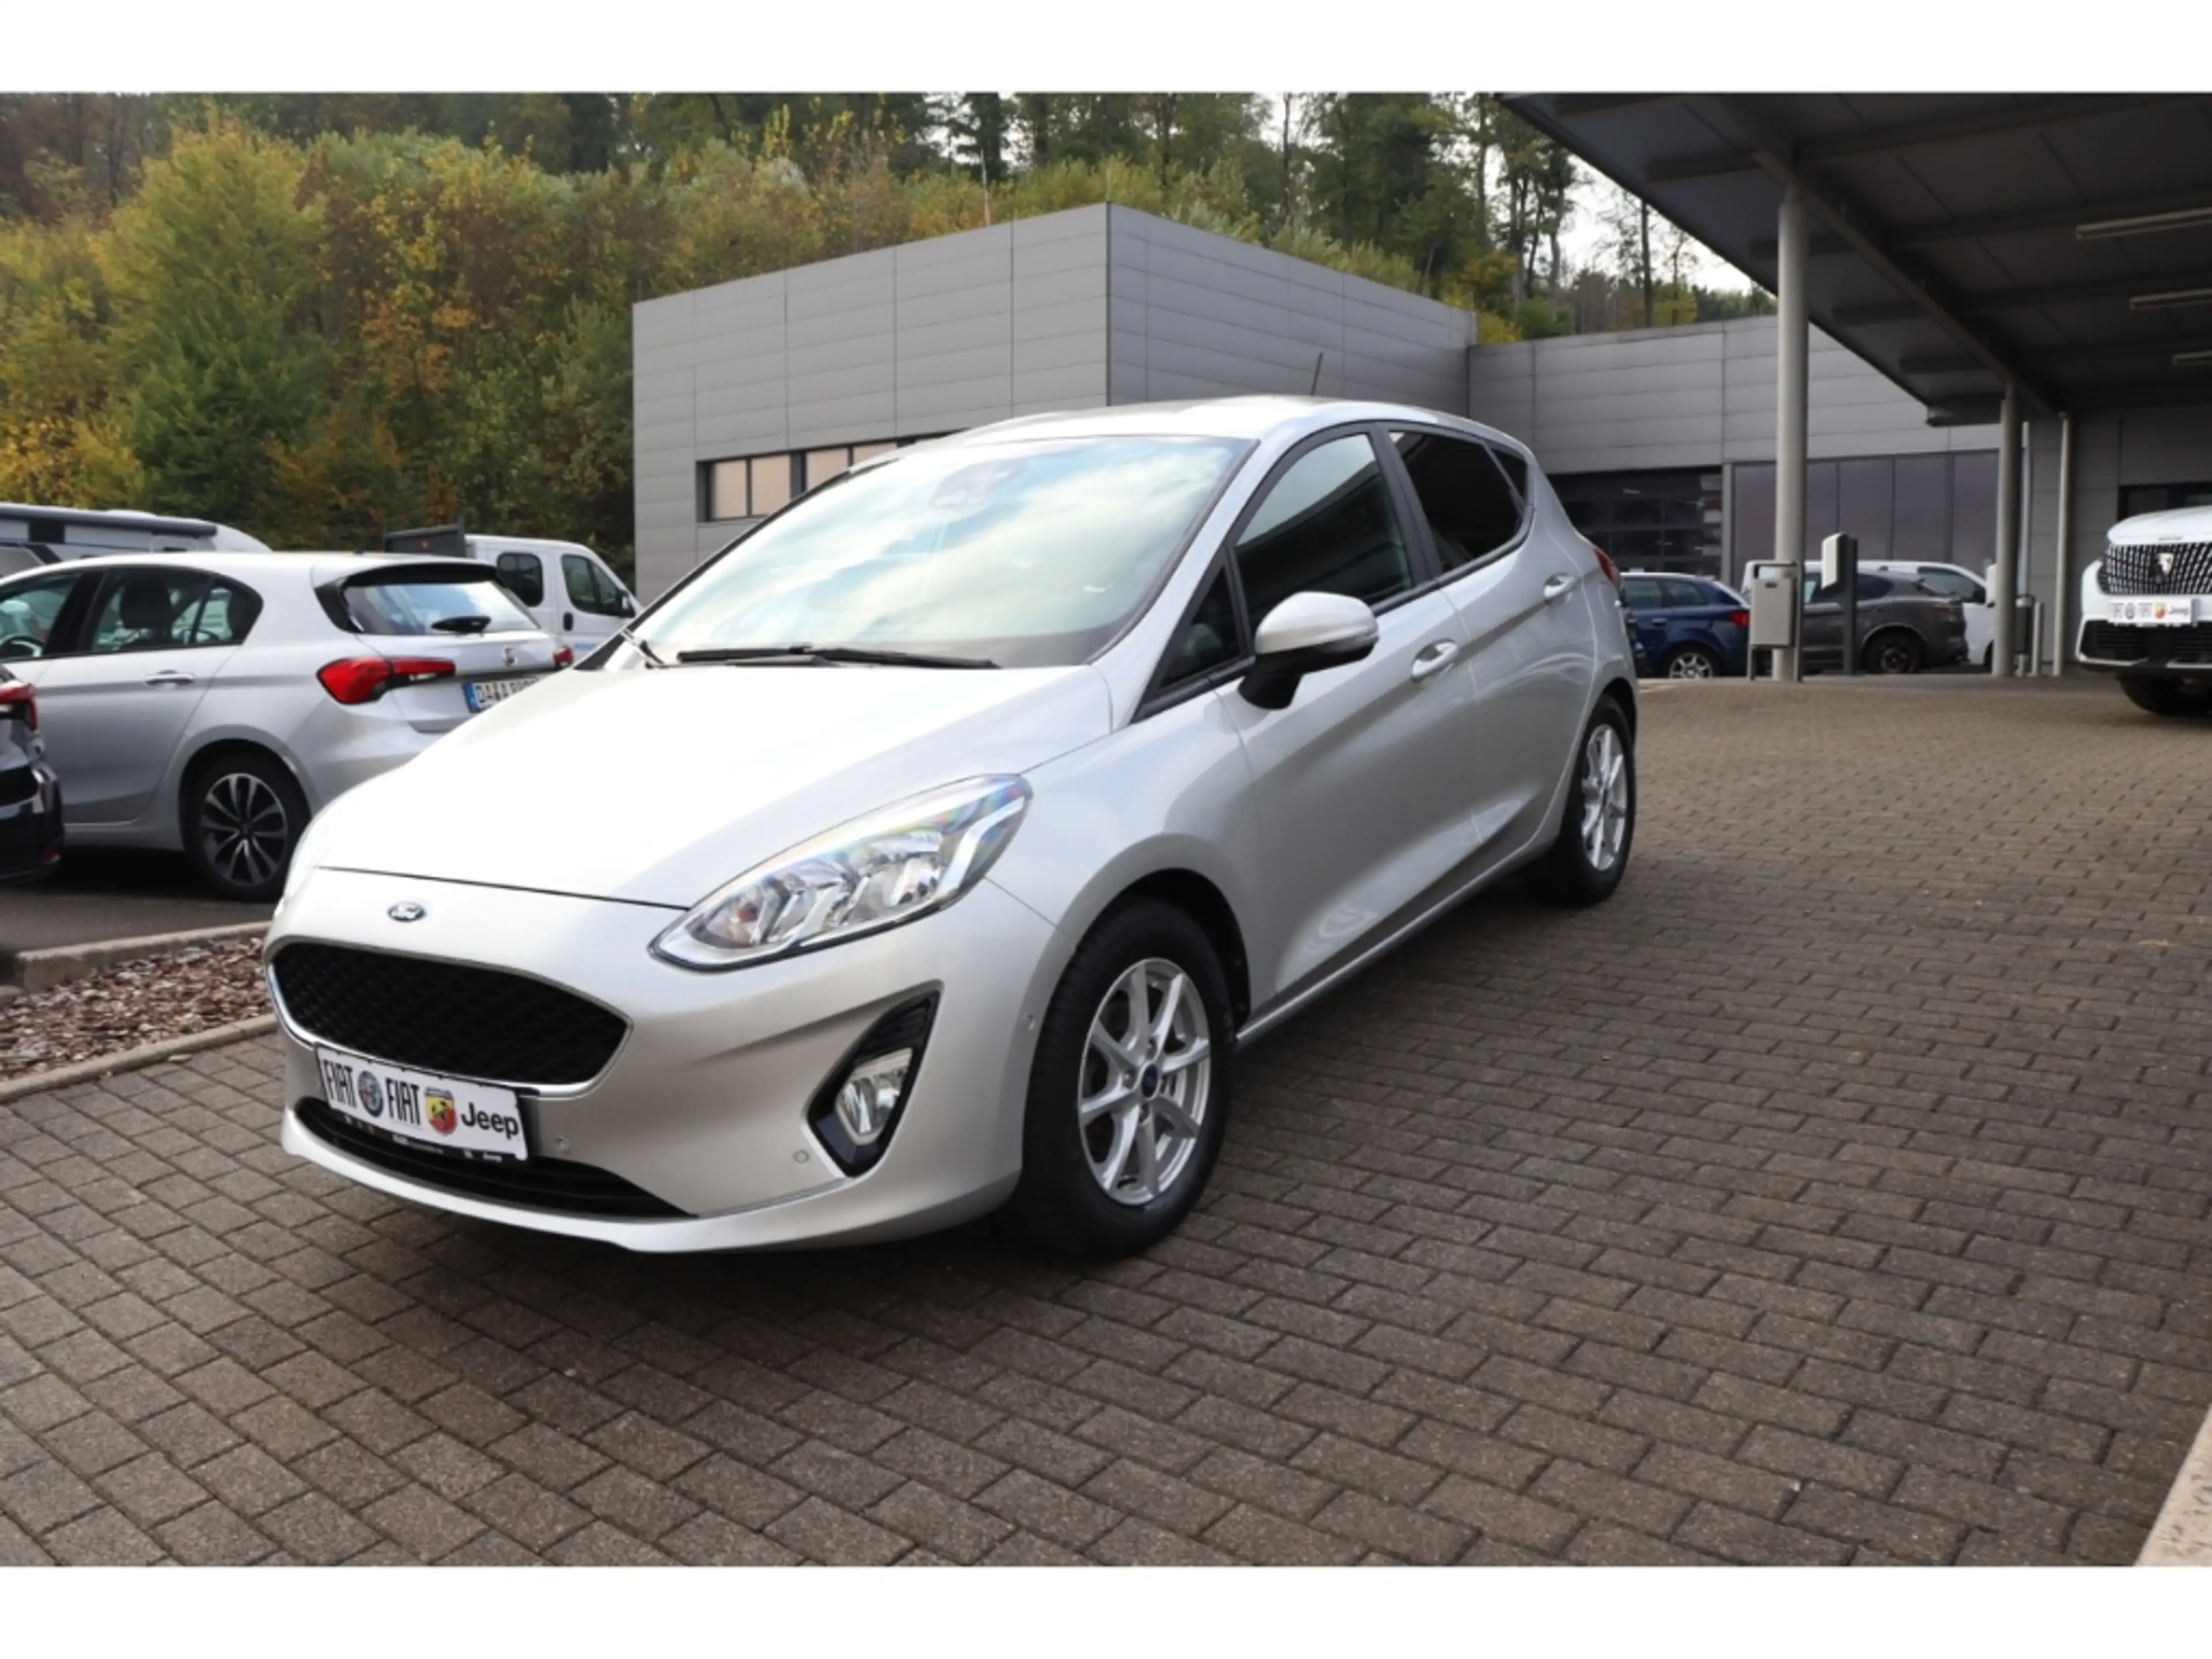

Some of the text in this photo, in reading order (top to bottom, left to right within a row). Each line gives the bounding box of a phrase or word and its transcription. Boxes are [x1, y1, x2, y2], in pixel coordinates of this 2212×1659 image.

[323, 1060, 518, 1139] FIAT FIAT Jeep
